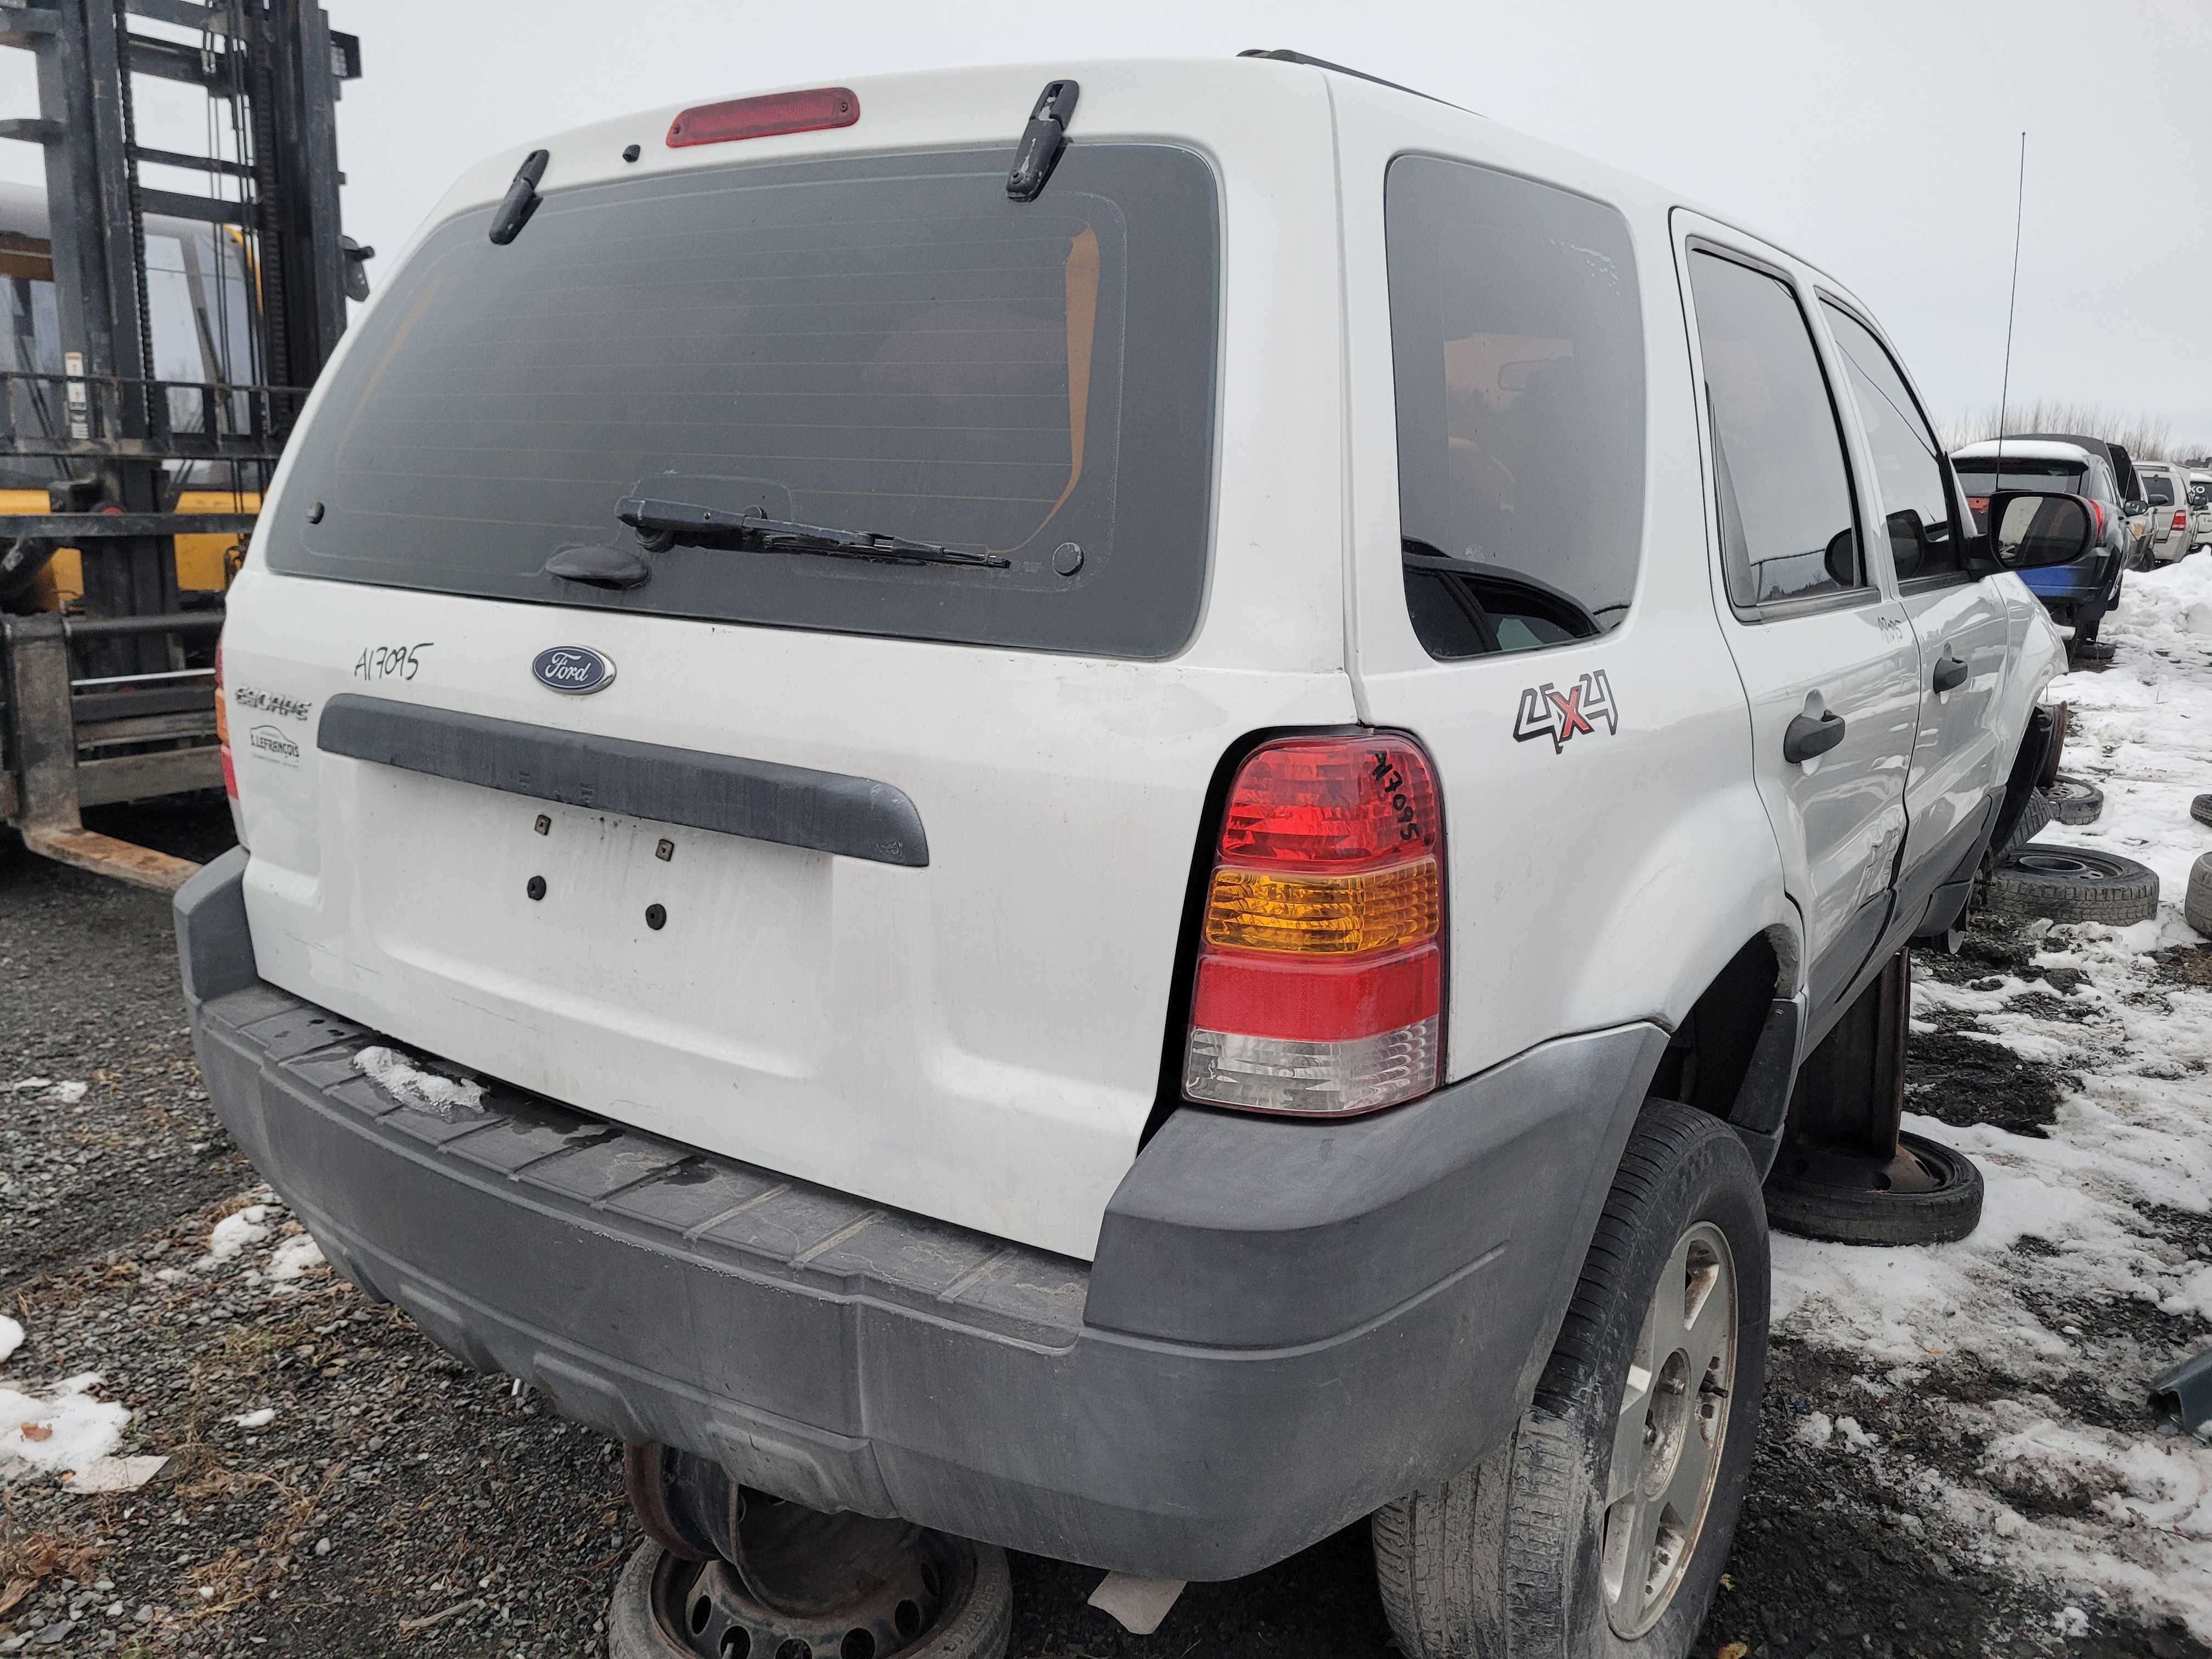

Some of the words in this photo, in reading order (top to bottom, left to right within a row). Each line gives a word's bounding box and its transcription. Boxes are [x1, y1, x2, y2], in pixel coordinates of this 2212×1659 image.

[354, 642, 434, 681] A17095
[545, 652, 592, 681] Ford
[1367, 749, 1421, 840] A17095
